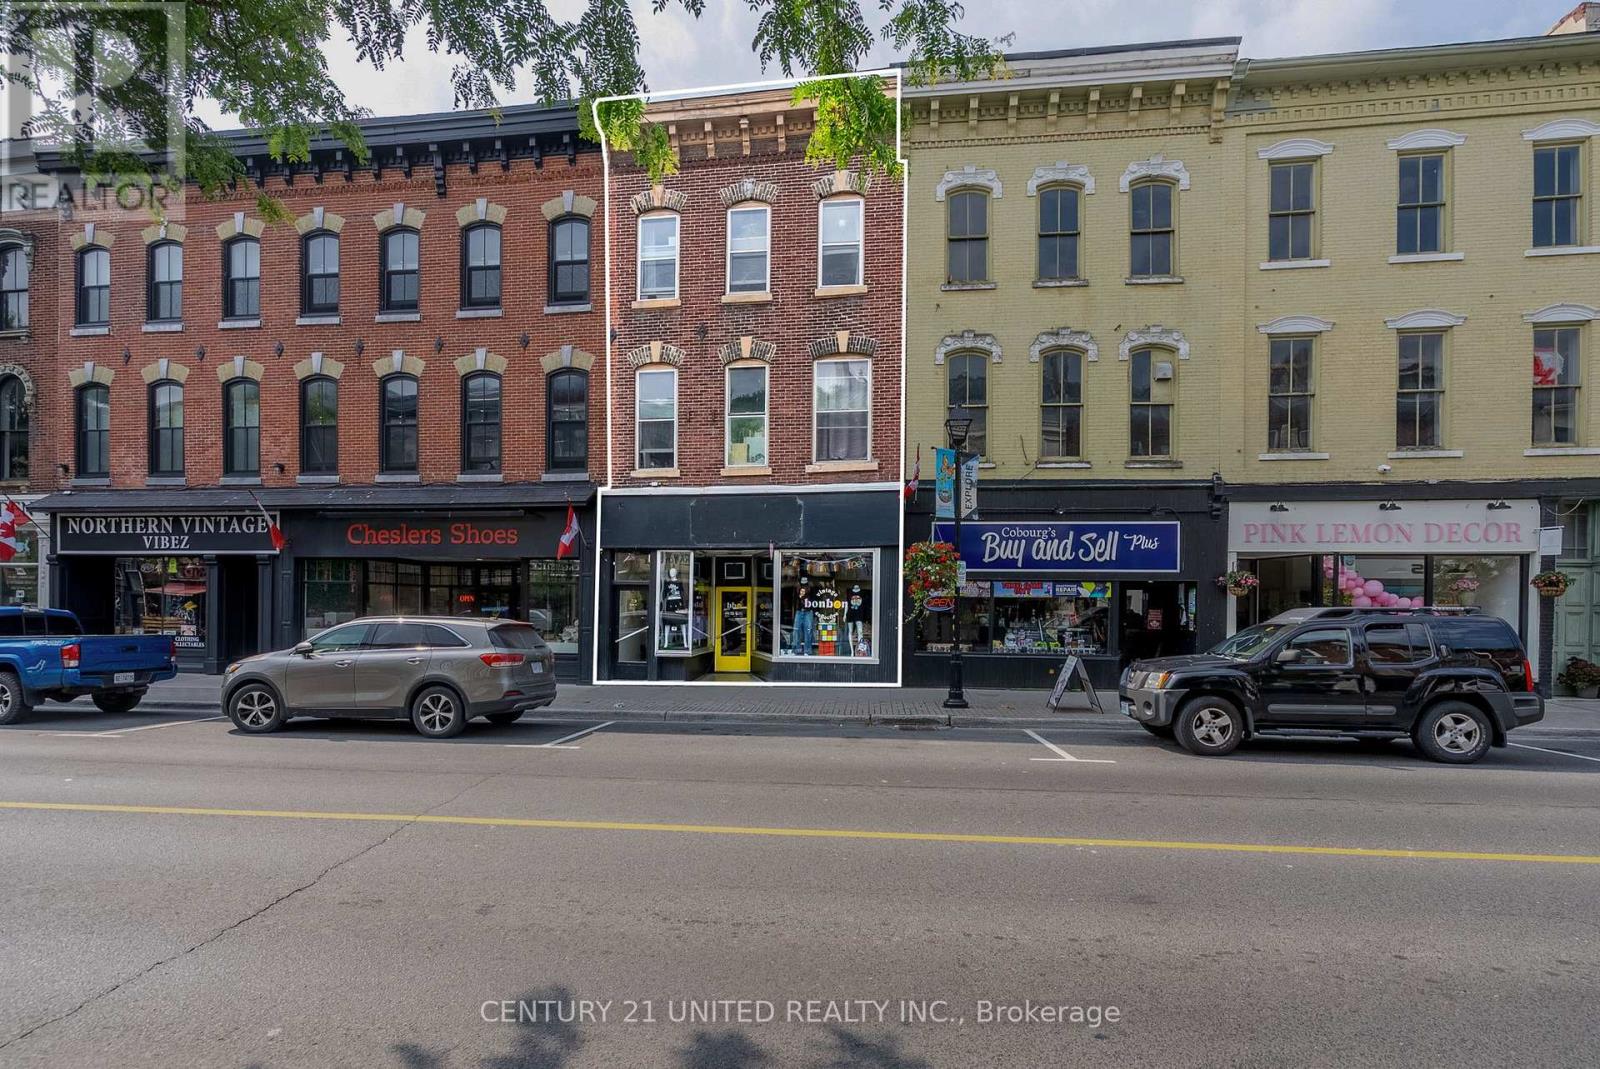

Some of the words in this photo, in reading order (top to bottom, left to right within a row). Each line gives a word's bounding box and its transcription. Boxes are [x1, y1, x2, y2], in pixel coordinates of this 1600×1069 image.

[964, 464, 974, 510] EXPLORE
[67, 517, 173, 534] NORTHERN
[179, 516, 268, 534] VINTAGE
[347, 524, 441, 544] Cheslers
[450, 523, 518, 544] Shoes
[1002, 527, 1056, 539] Cobourg's
[1242, 523, 1306, 544] PINK
[1315, 523, 1413, 544] LEMON
[1424, 522, 1522, 544] DECOR
[142, 535, 190, 549] VIBEZ
[981, 532, 1026, 567] Buy
[1032, 530, 1075, 561] and
[1078, 530, 1119, 562] Sell
[1124, 533, 1160, 550] Plus
[816, 587, 838, 597] vintage
[804, 598, 848, 609] bonbon
